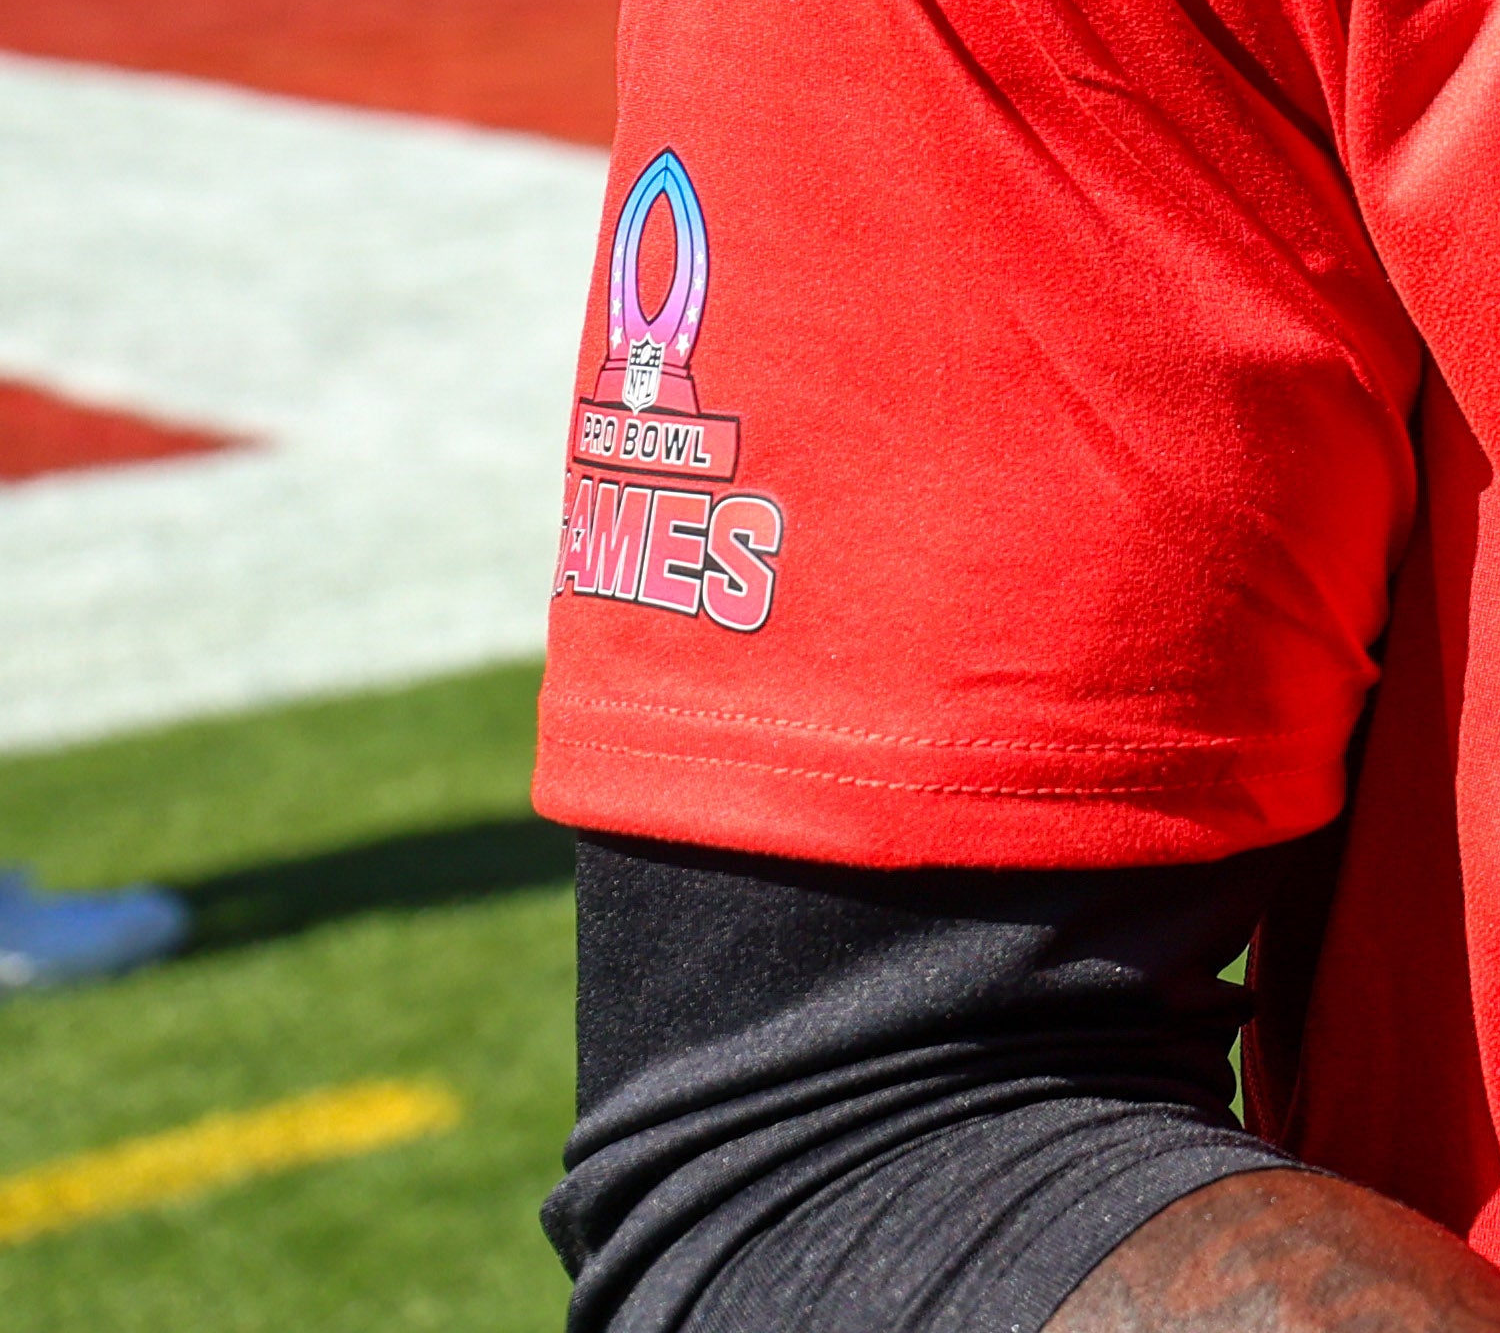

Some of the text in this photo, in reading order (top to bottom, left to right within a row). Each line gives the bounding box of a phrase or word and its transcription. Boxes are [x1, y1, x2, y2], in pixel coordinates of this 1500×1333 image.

[625, 366, 653, 399] NFL
[580, 412, 712, 469] PRO BOWL
[554, 472, 784, 633] AMES
